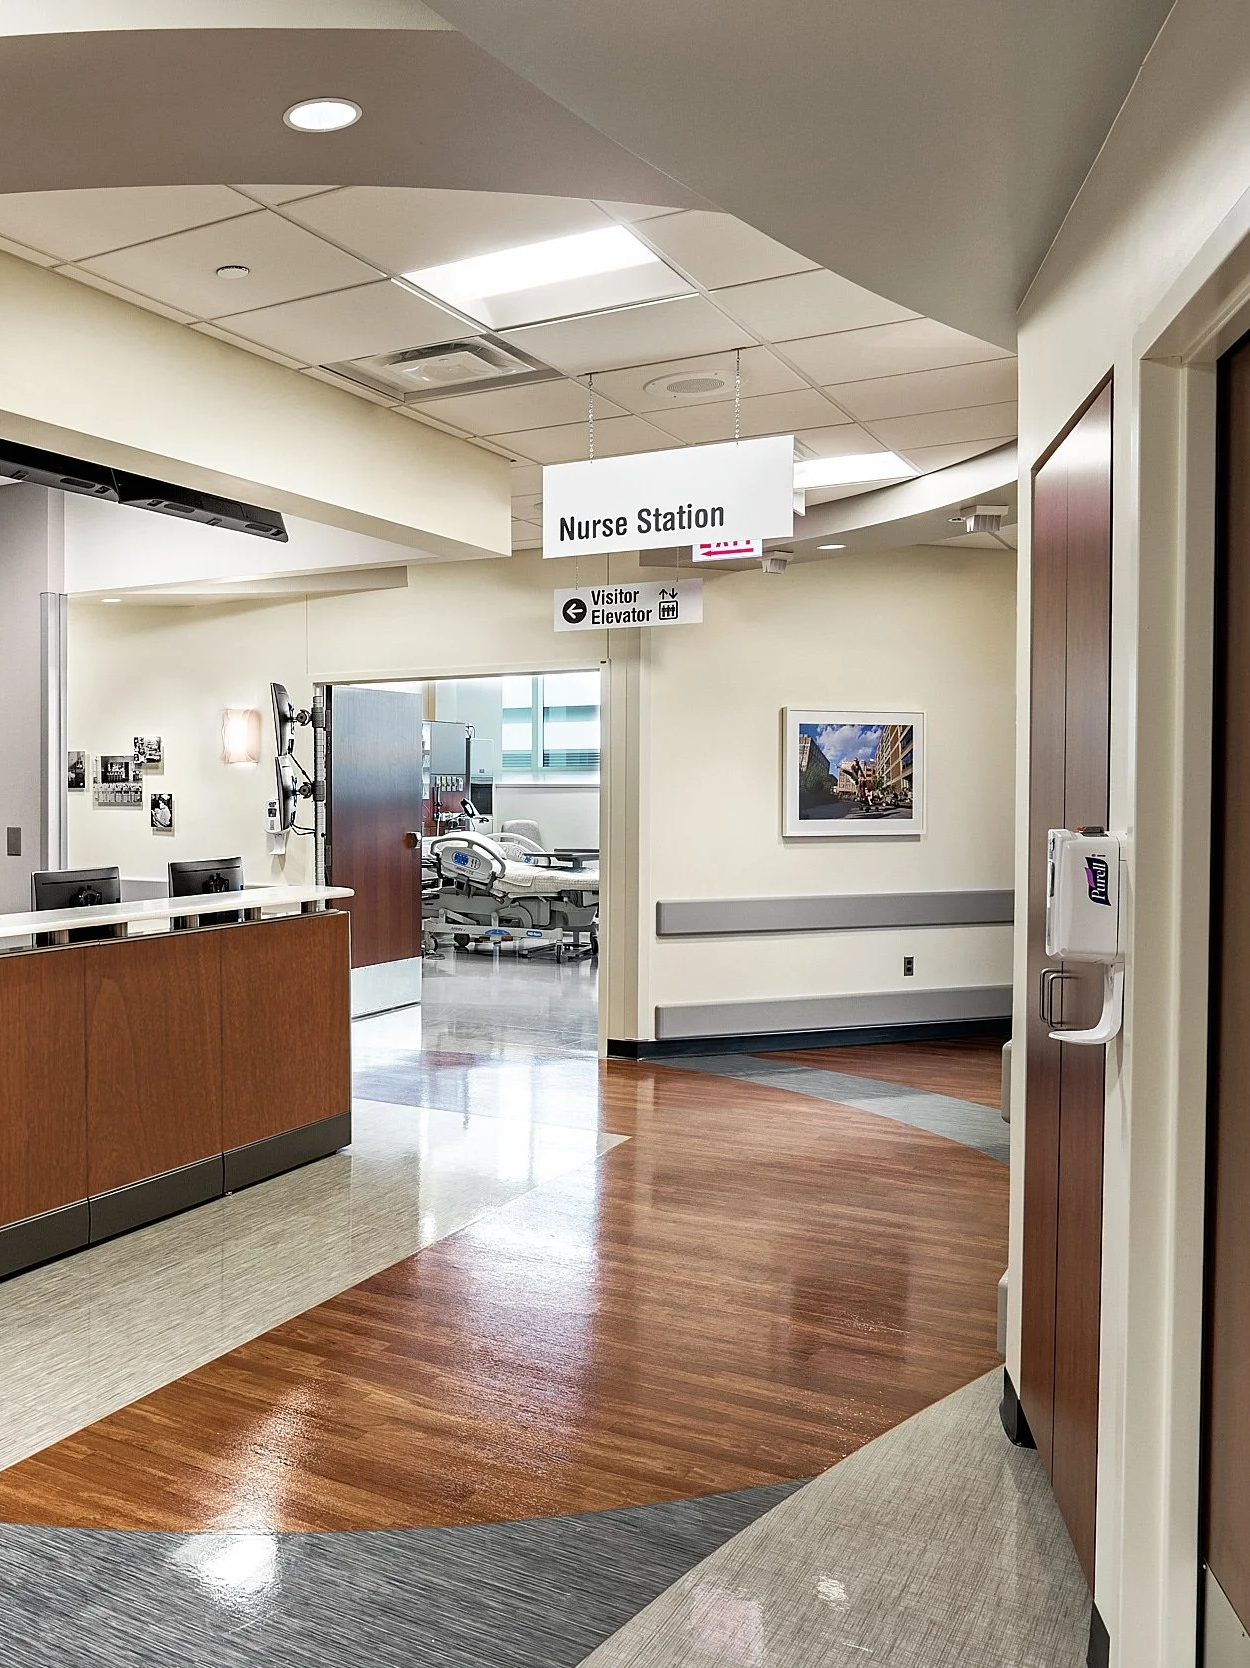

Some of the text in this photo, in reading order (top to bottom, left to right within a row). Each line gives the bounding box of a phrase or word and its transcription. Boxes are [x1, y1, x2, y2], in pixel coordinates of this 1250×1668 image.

[559, 503, 724, 542] Nurse Station
[591, 588, 640, 606] Visitor
[591, 607, 653, 625] Elevator
[1091, 862, 1106, 900] Purell
